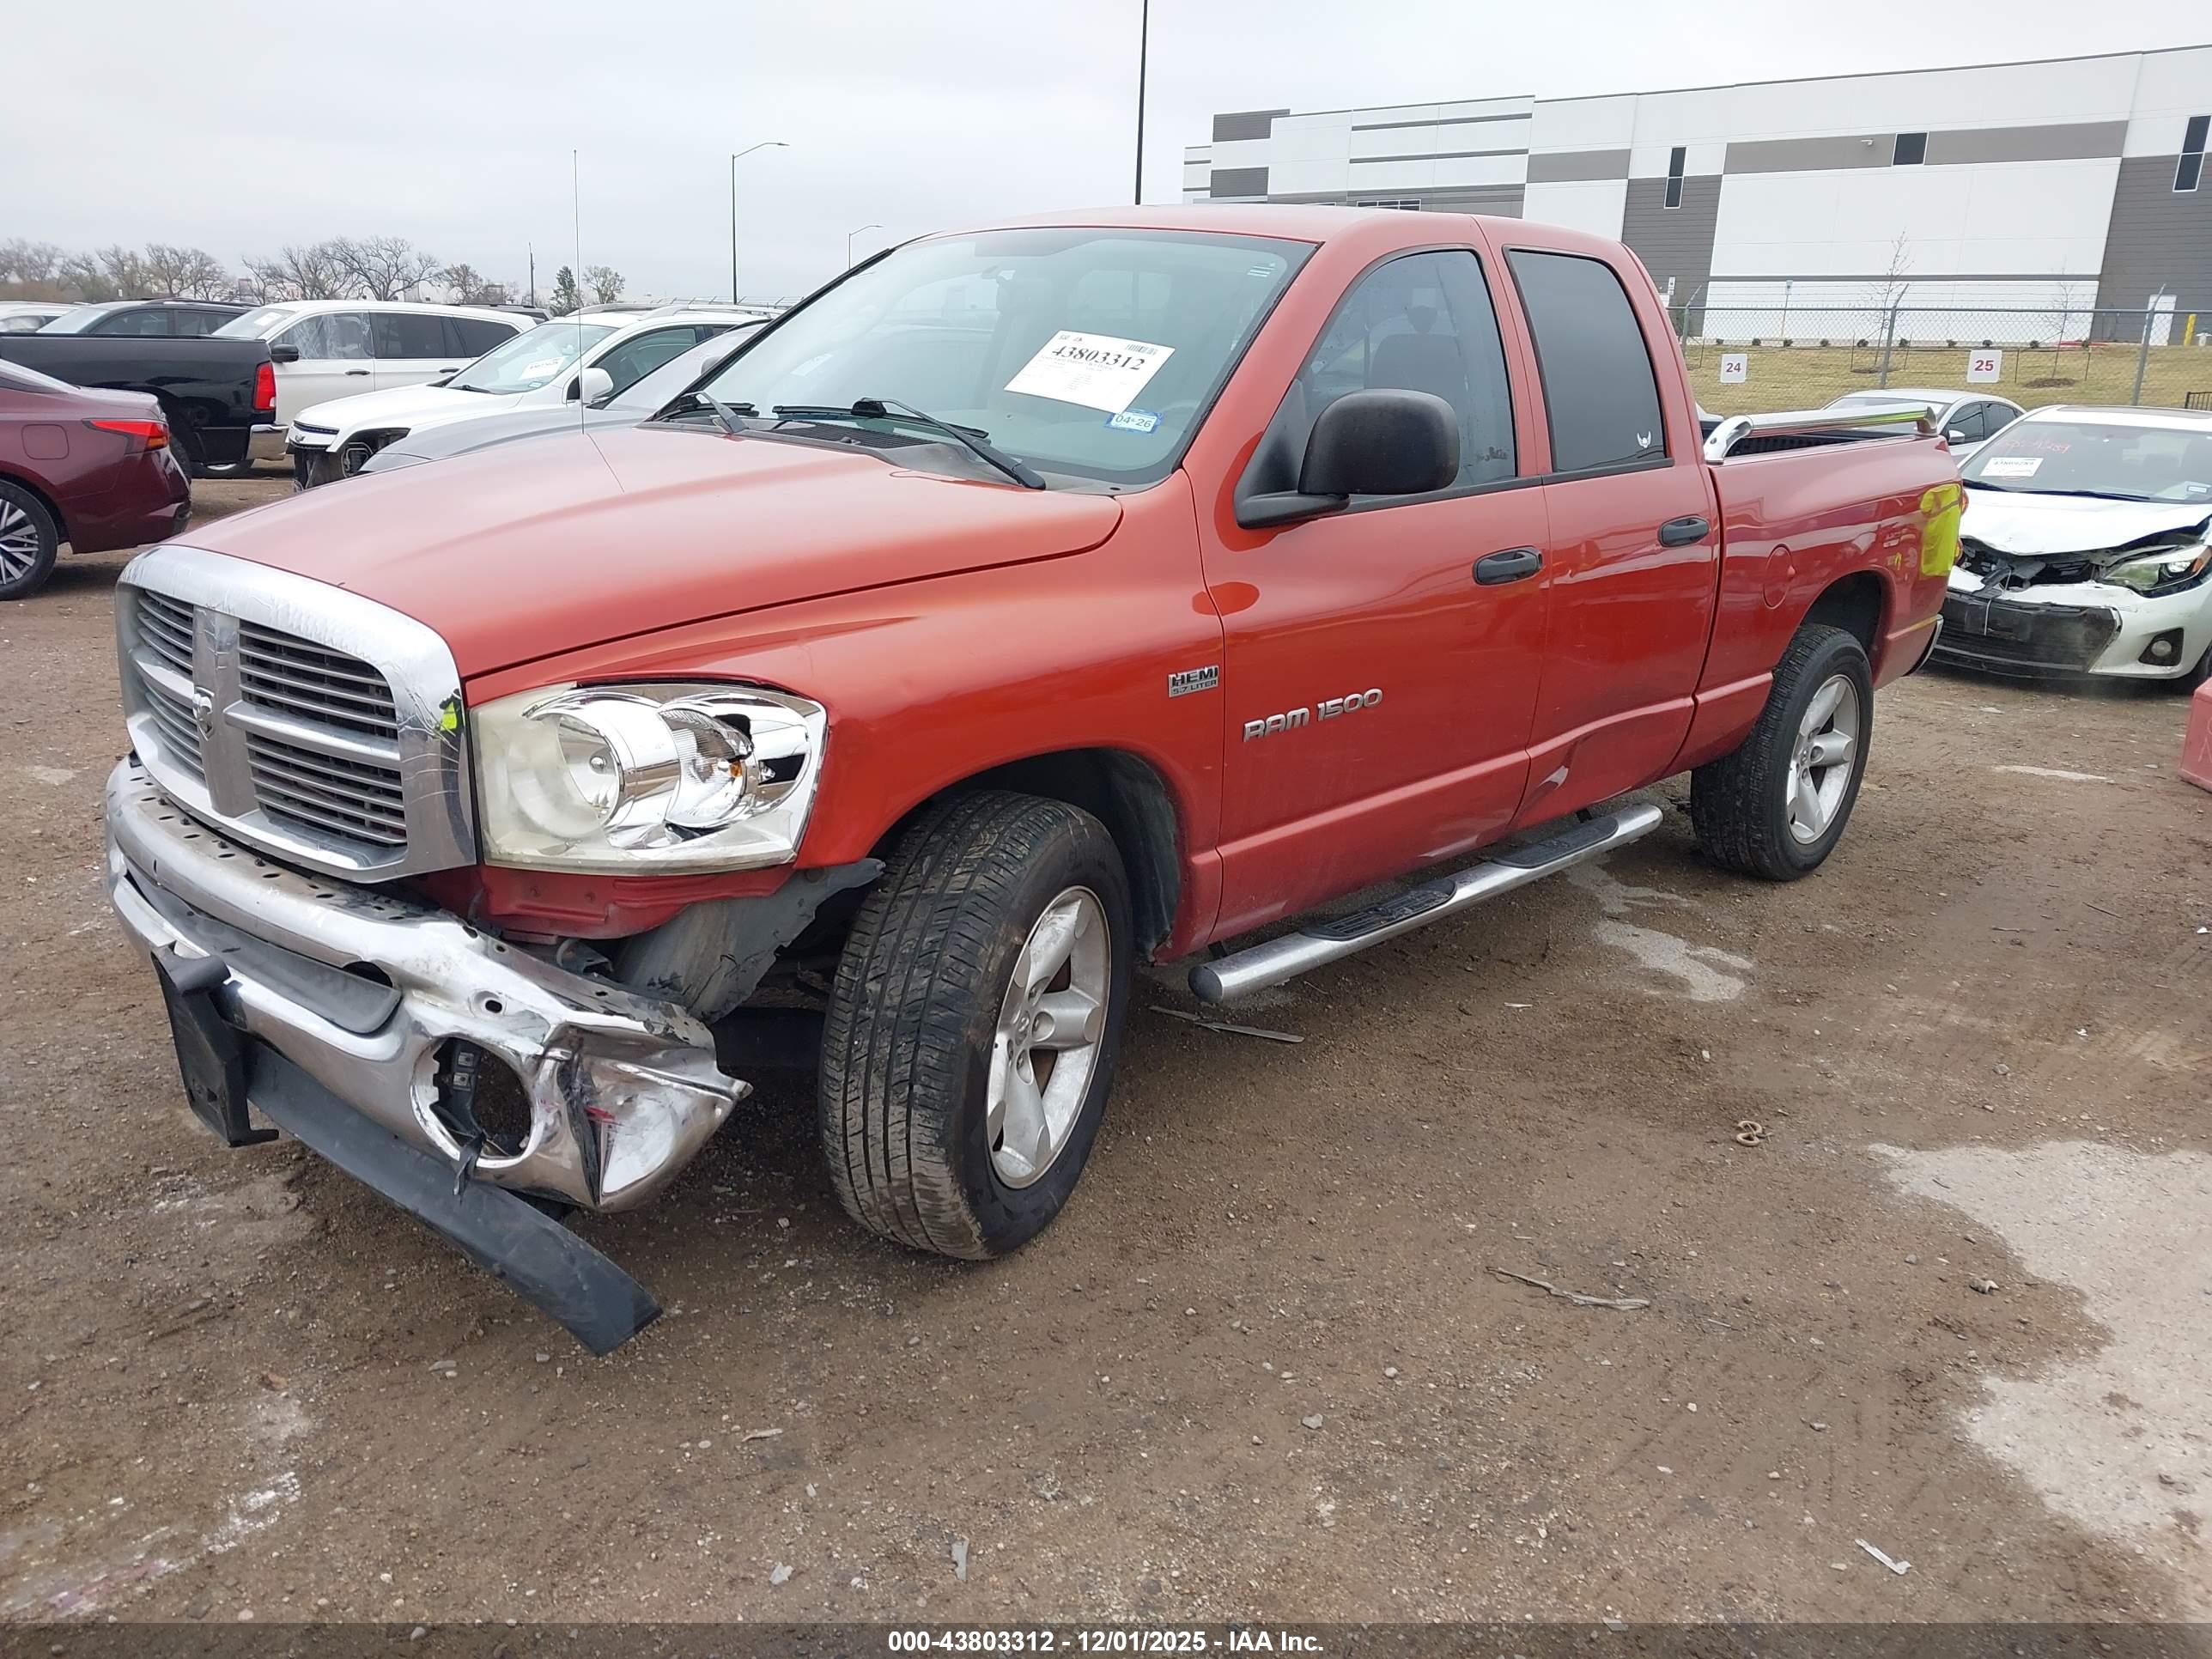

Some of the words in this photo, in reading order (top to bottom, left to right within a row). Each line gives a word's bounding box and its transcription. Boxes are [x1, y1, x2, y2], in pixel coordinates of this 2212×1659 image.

[1052, 345, 1145, 370] 43803312
[1974, 359, 1994, 372] 25
[1725, 362, 1741, 373] 24
[1171, 665, 1218, 687] HEMI
[1172, 685, 1188, 695] 5.7
[1191, 679, 1217, 691] LITER
[1243, 707, 1310, 742] RAM
[1317, 688, 1383, 721] 1500
